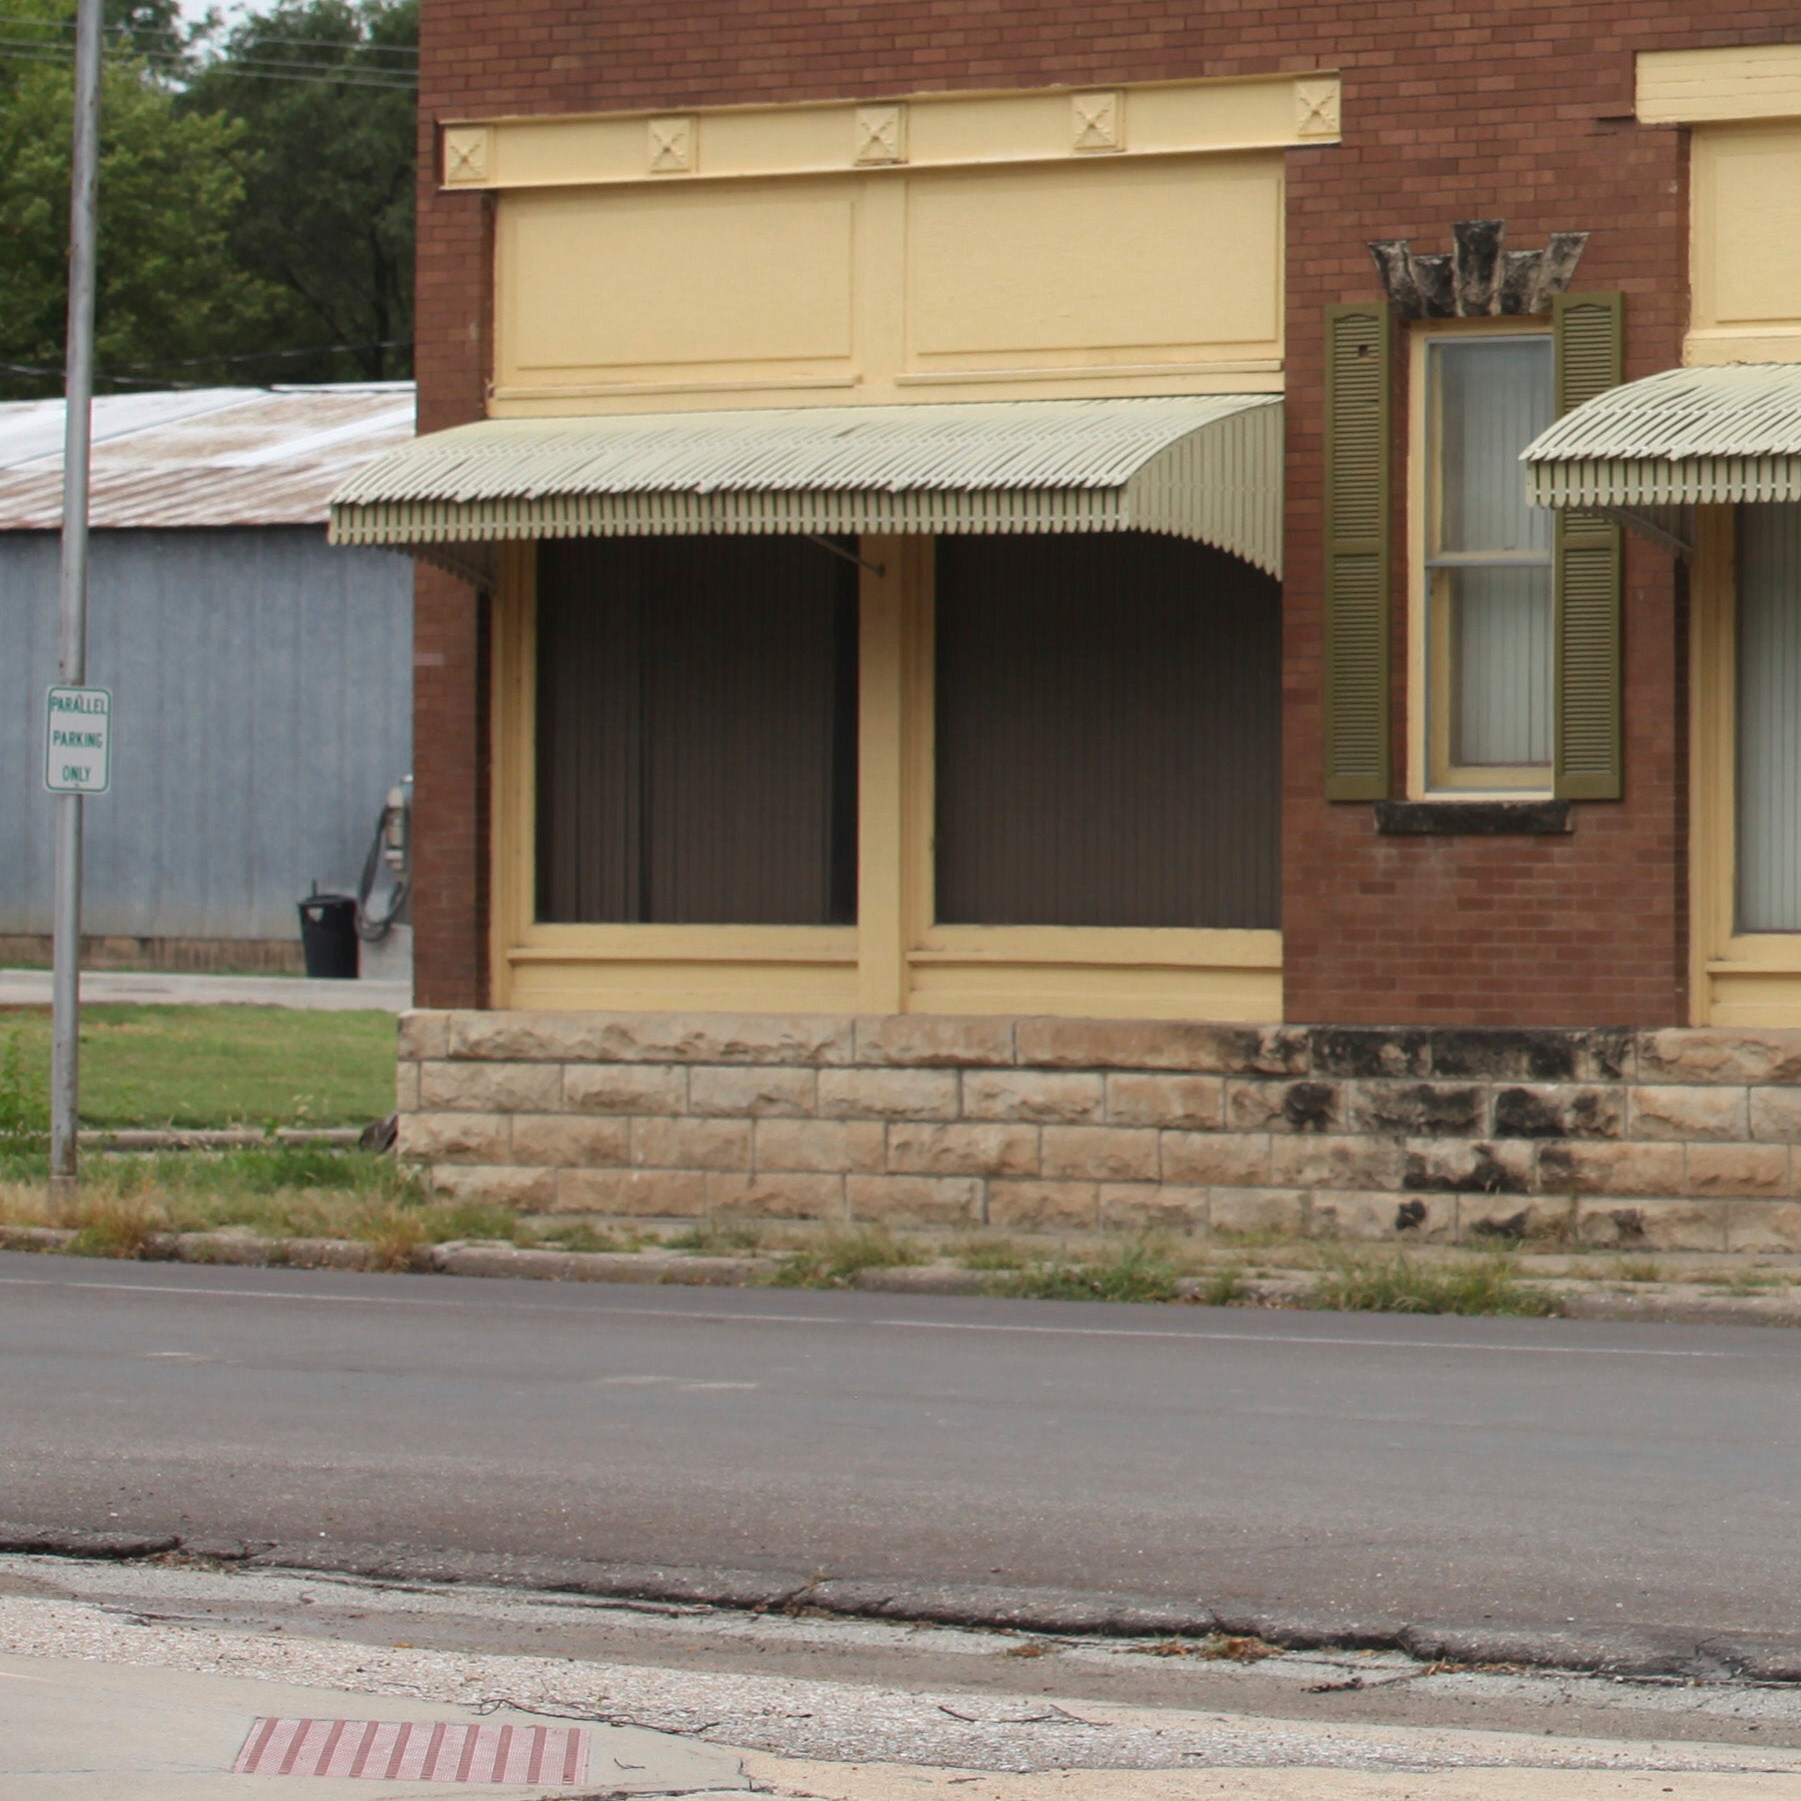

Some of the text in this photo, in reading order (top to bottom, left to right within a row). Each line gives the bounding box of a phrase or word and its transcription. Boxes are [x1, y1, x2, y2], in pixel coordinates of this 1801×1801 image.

[50, 696, 107, 715] PARALLEL
[53, 730, 103, 748] PARKING
[62, 765, 91, 782] ONLY
